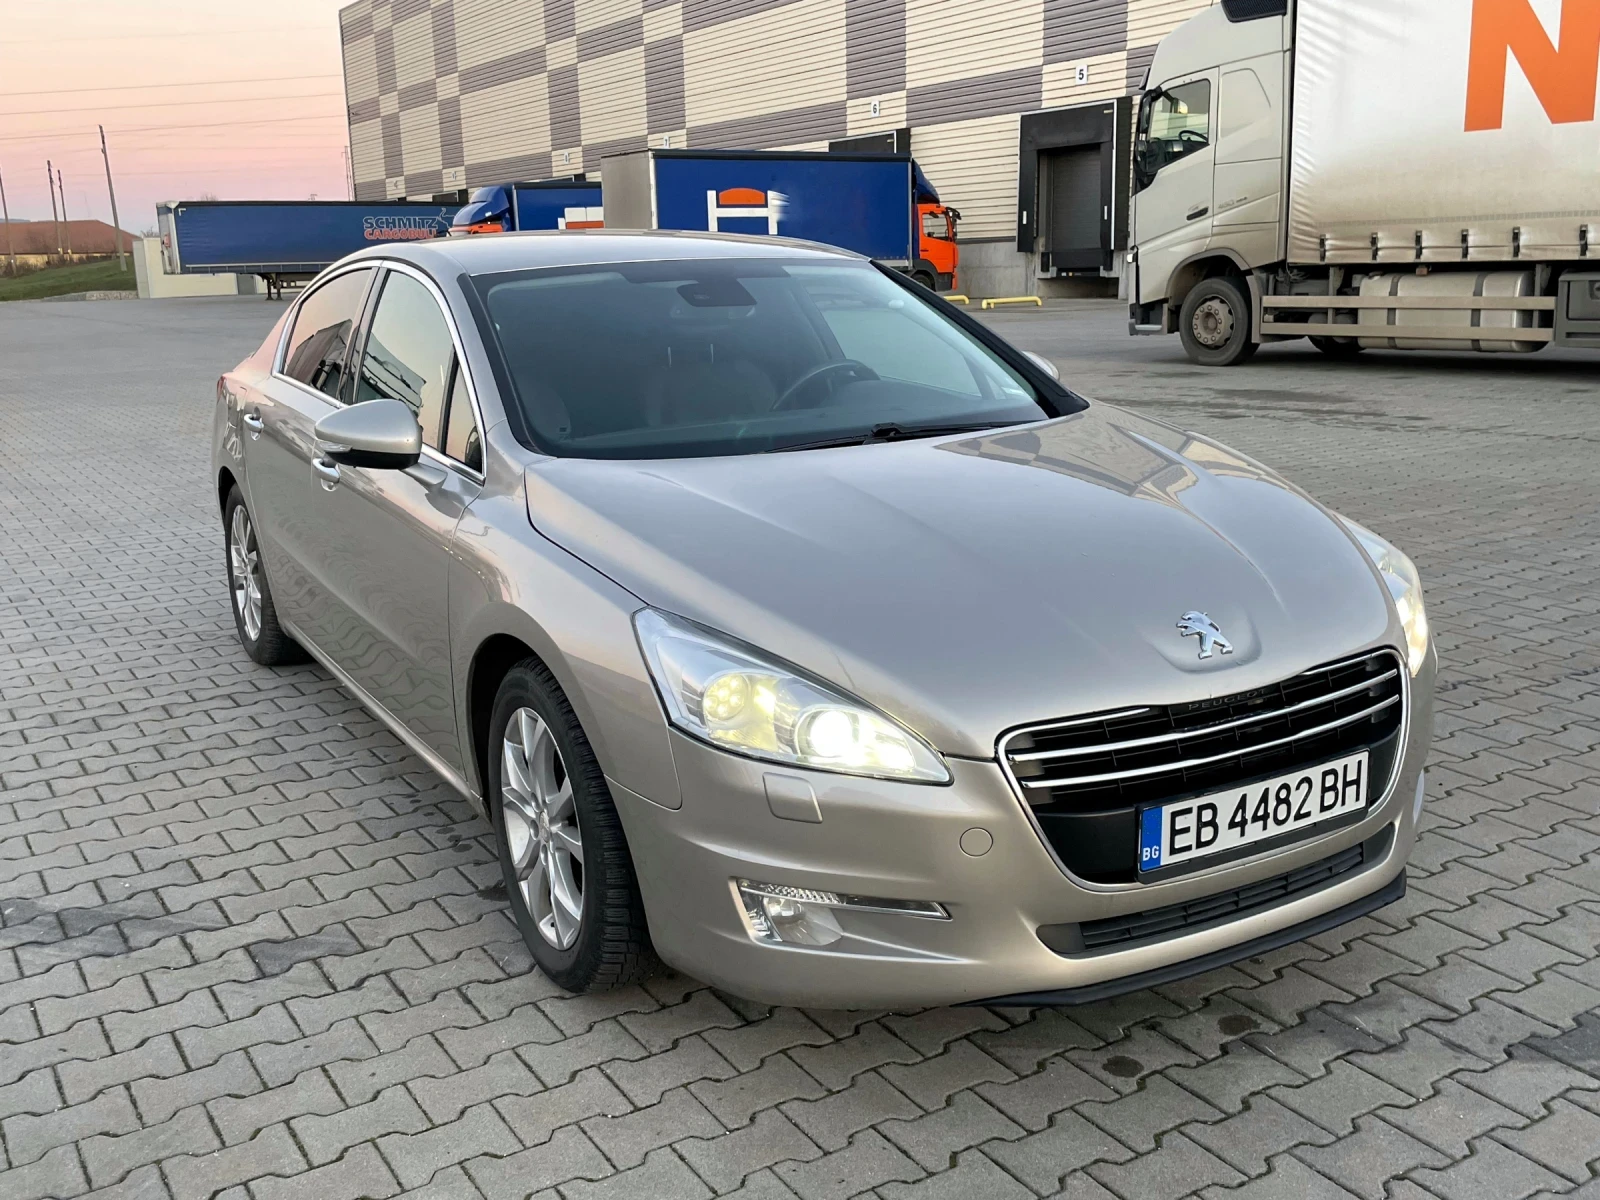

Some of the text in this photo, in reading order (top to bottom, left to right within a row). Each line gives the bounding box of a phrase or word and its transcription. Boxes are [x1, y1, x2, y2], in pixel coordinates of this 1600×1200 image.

[1464, 0, 1600, 132] N
[1078, 68, 1085, 81] 5
[872, 103, 878, 114] 6
[363, 216, 439, 229] SCHMITZ
[1188, 688, 1265, 711] PEUGEOT
[1168, 759, 1363, 857] EB 4482 BH
[1142, 846, 1159, 861] BG
